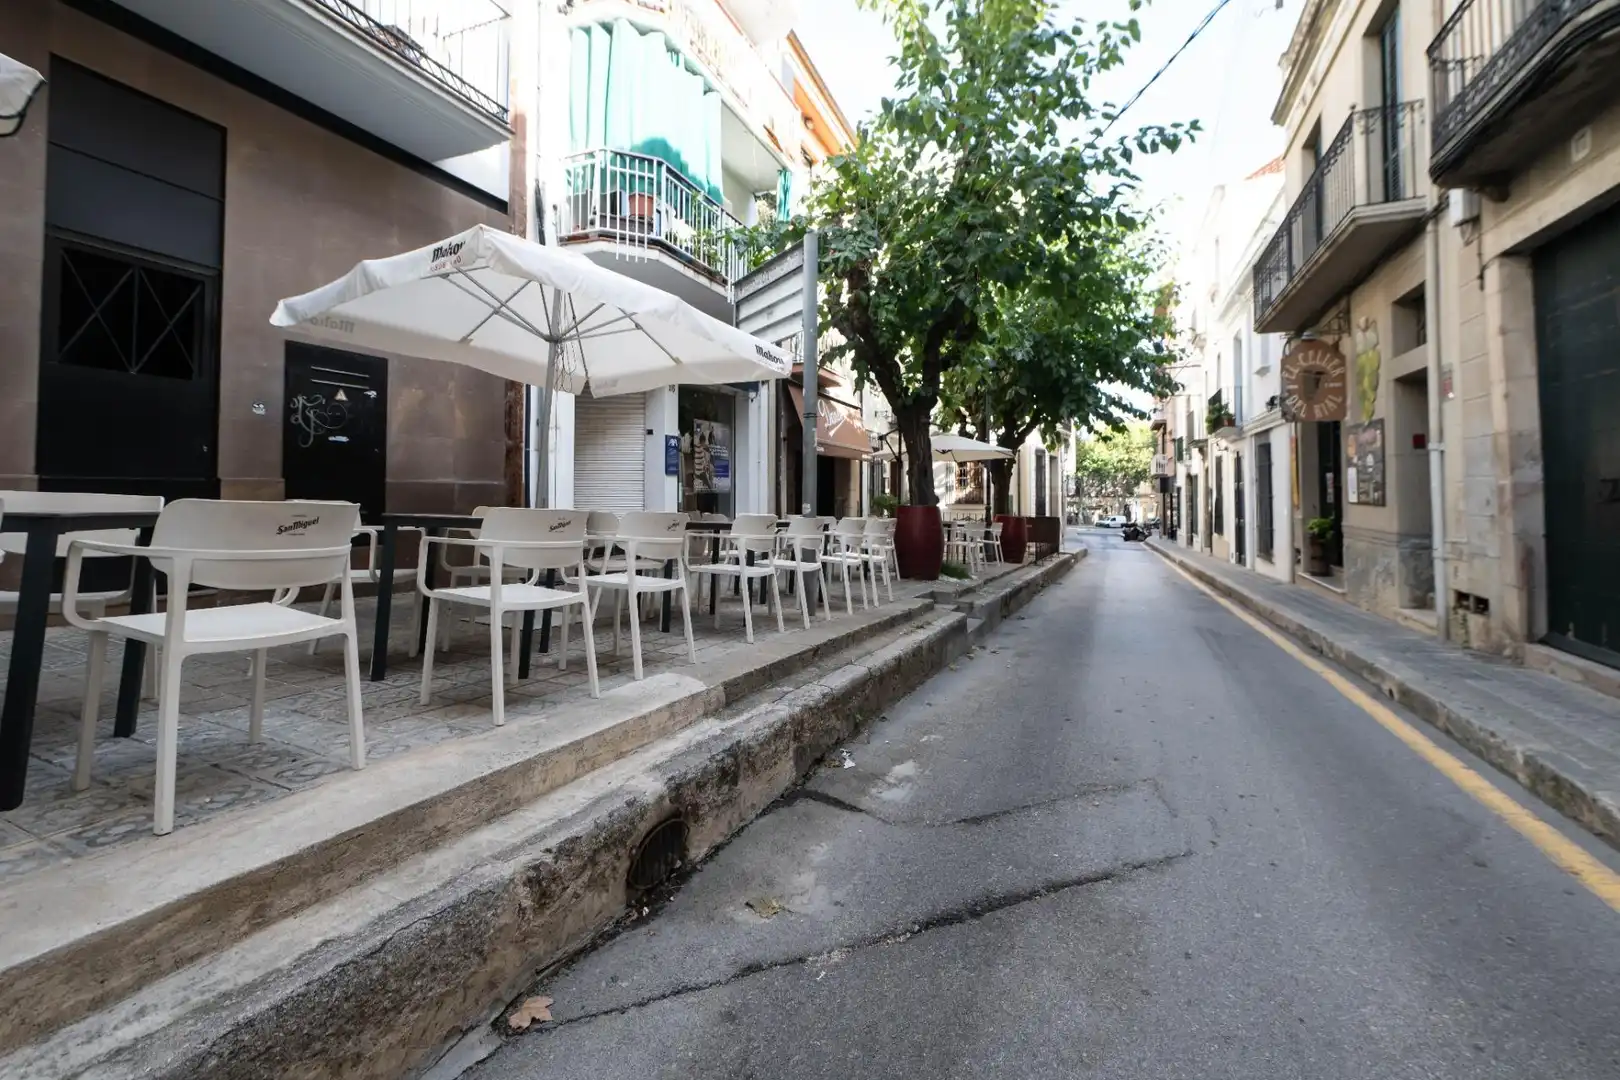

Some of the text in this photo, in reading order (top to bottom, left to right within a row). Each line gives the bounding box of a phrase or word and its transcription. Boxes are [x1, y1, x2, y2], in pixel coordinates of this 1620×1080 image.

[1282, 350, 1345, 379] EL CELLER
[1286, 394, 1307, 417] DEL
